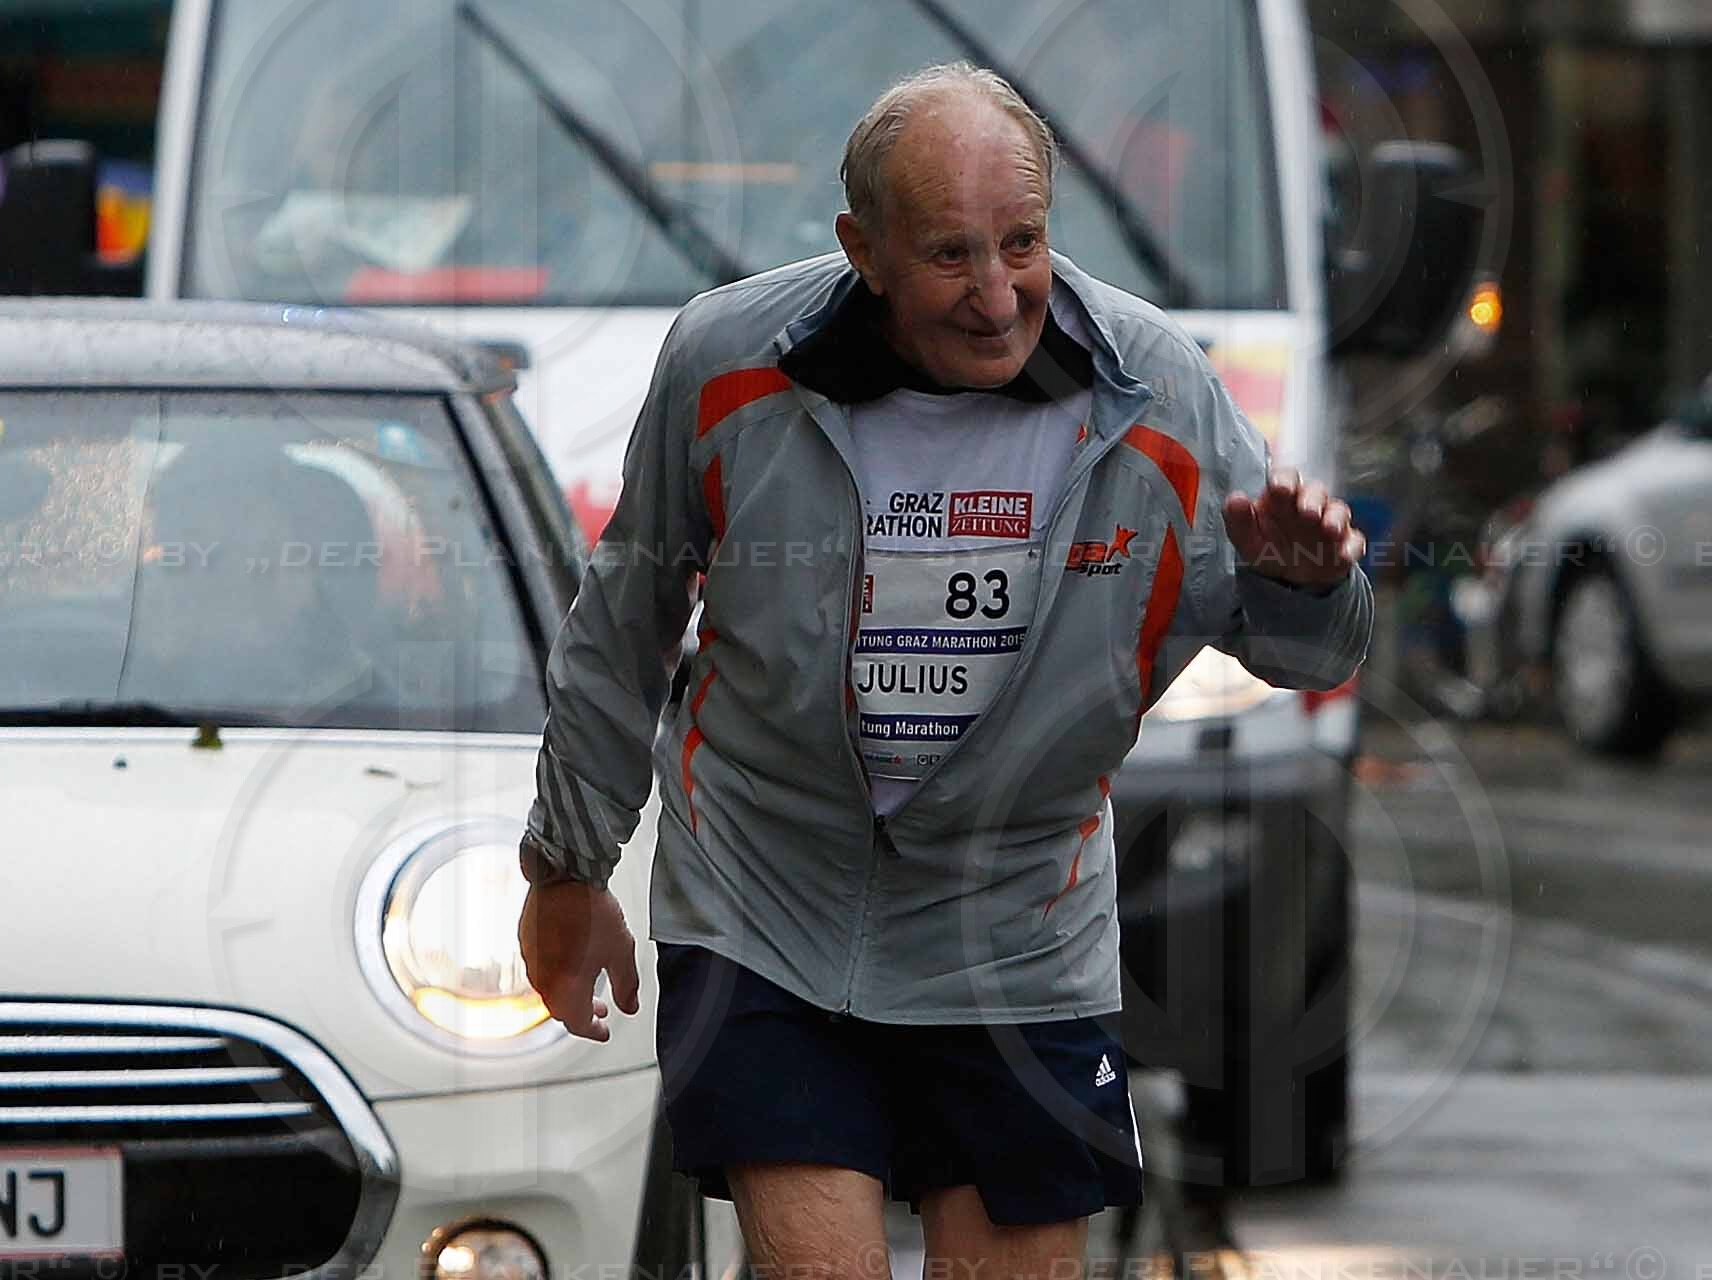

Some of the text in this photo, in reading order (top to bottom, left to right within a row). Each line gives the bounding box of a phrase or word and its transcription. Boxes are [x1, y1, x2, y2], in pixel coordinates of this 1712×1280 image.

[888, 492, 945, 515] GRAZ
[953, 495, 1028, 516] KLEINE
[950, 517, 1027, 535] ZEITUNG
[945, 569, 1010, 621] 83
[896, 635, 929, 648] GRAZ
[931, 636, 997, 649] MARATHON
[856, 663, 969, 695] JULIUS
[894, 721, 960, 736] Marathon
